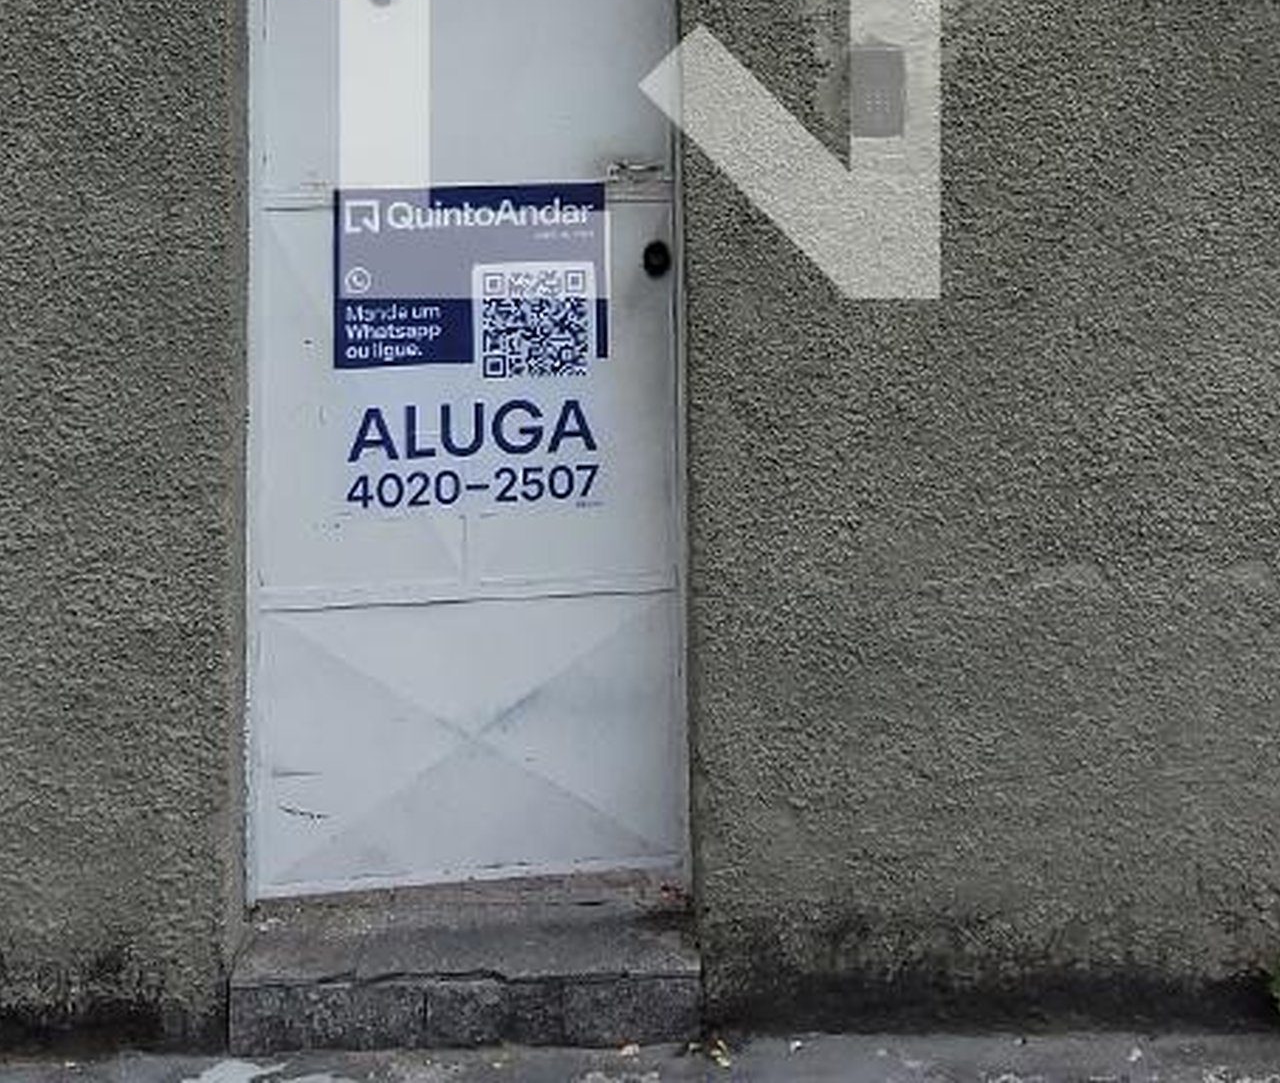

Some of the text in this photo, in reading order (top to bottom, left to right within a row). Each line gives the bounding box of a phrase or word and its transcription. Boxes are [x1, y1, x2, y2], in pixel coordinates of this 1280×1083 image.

[387, 198, 594, 231] QuintoAndar
[412, 305, 441, 319] um
[345, 323, 442, 341] Whatsapp
[346, 346, 370, 359] ou
[347, 400, 598, 462] ALUGA
[347, 464, 600, 508] 4020-2507
